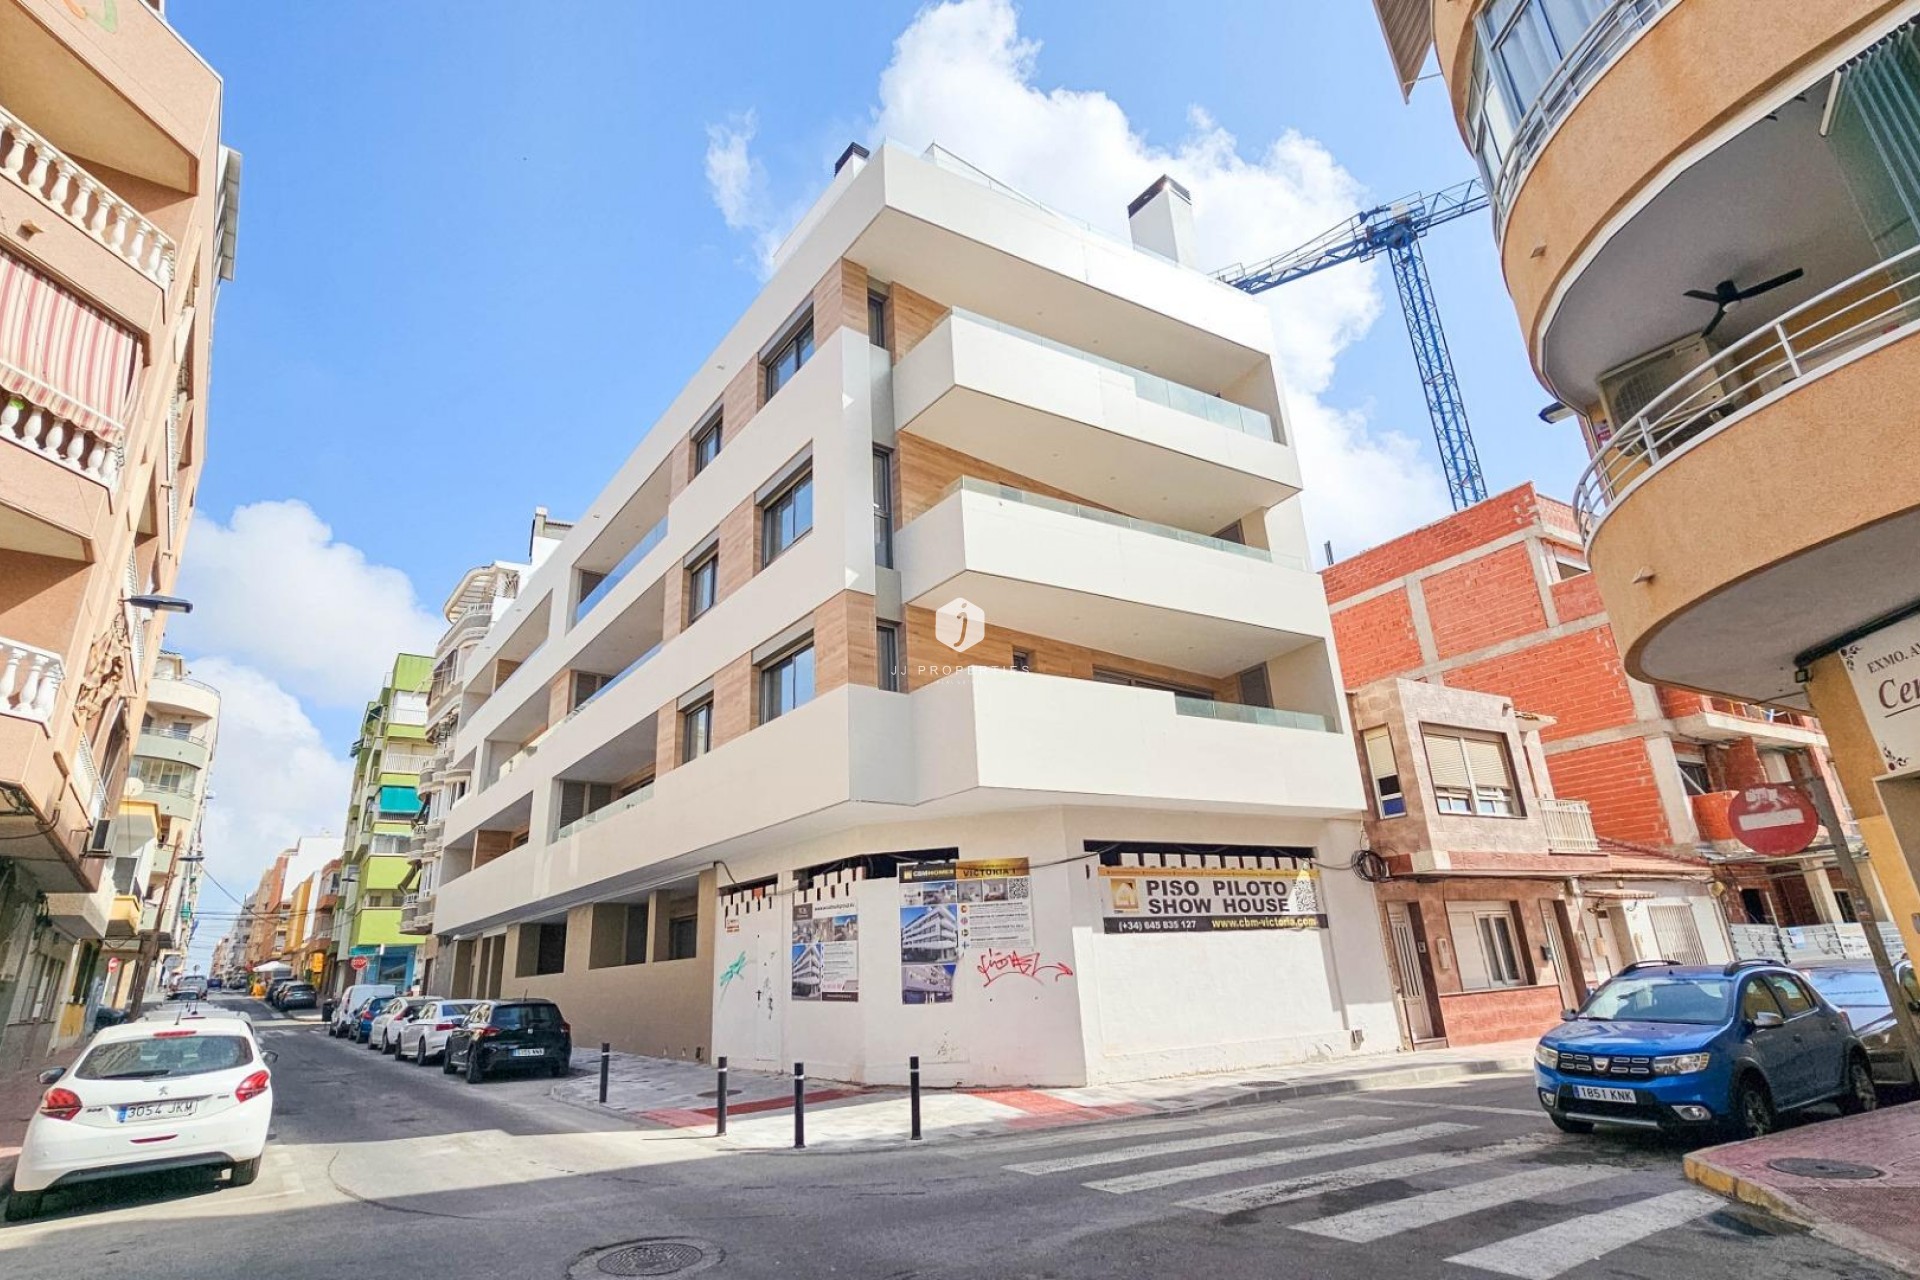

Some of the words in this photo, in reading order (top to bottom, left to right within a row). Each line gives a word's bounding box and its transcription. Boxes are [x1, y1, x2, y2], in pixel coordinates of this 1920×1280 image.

[1867, 650, 1908, 673] EXMO.
[963, 868, 1008, 877] VICTORIA
[1146, 880, 1200, 896] PISO
[1212, 880, 1287, 896] PILOTO
[1148, 899, 1211, 914] SHOW
[1224, 898, 1290, 913] HOUSE
[1118, 921, 1143, 932] (+34)
[1180, 920, 1197, 928] 127
[1211, 916, 1317, 929] www.cbm-victoria.com
[1581, 1087, 1607, 1099] 1851
[1609, 1089, 1634, 1101] KNK
[128, 1105, 162, 1118] 3054
[167, 1101, 193, 1114] JKM
